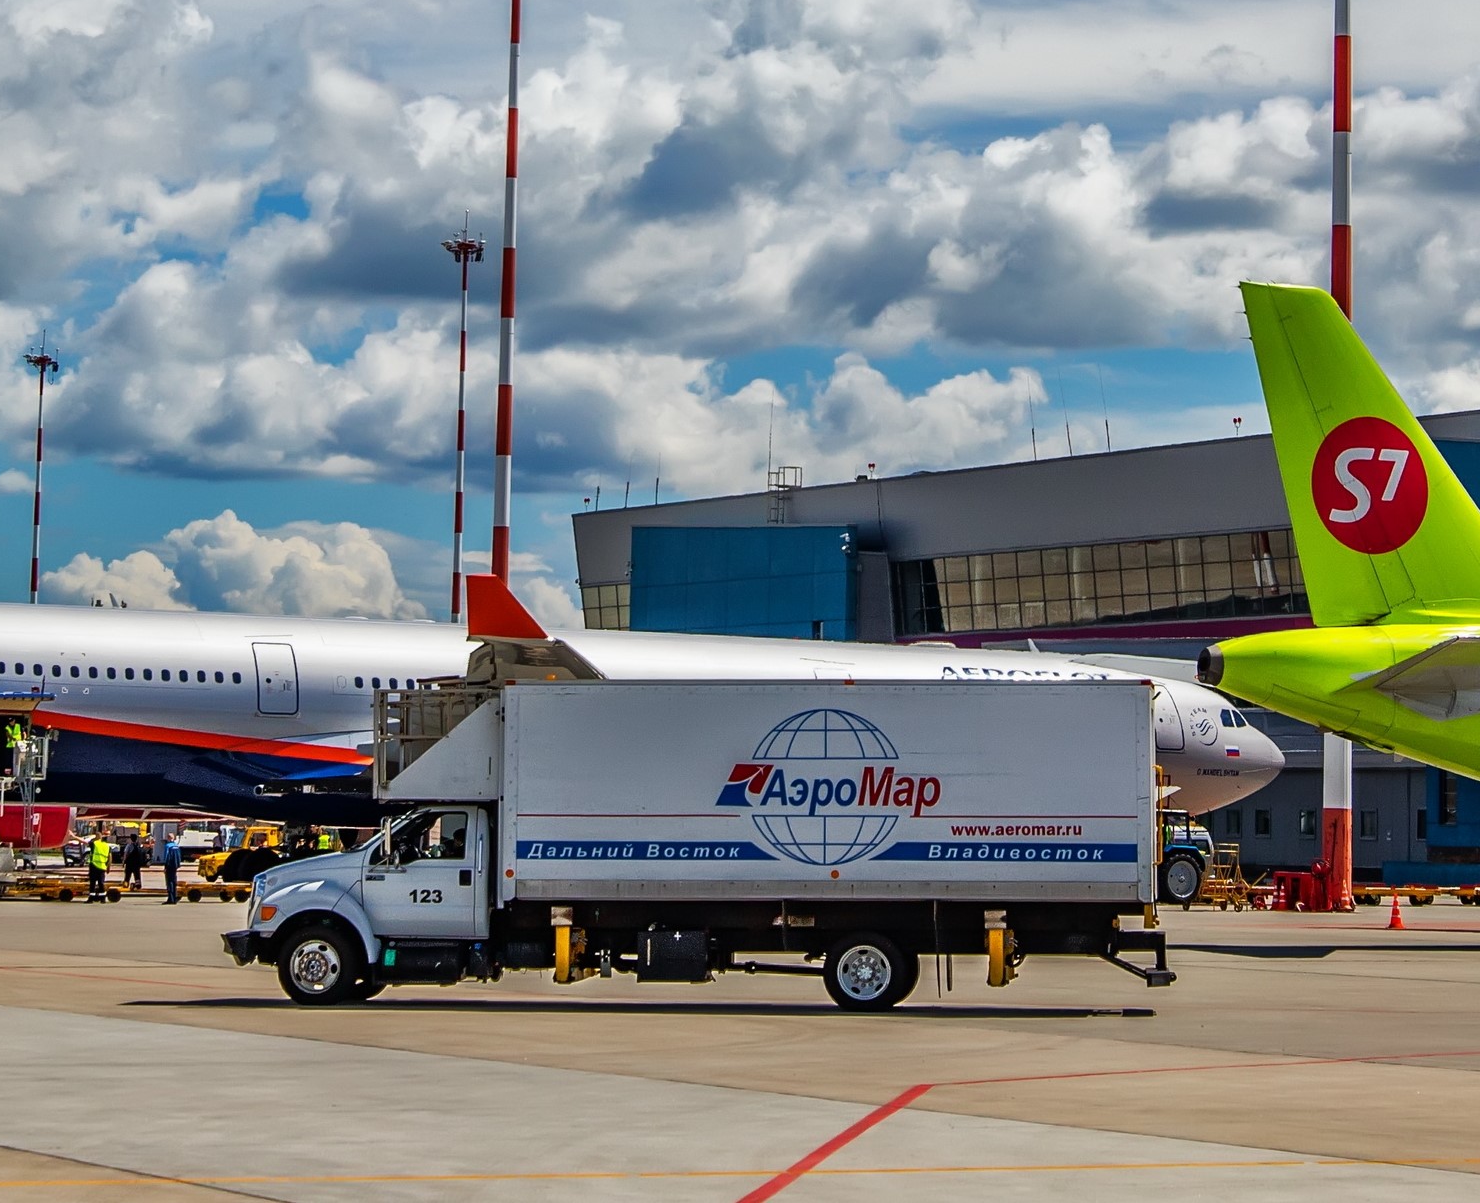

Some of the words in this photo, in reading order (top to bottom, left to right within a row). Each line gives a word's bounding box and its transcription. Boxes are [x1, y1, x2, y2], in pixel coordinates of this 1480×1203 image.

[1329, 447, 1409, 523] S7
[760, 766, 941, 817] АэроМар
[951, 825, 1082, 836] www.aeromar.ru
[527, 843, 635, 858] Дальний
[646, 844, 740, 858] Восток
[928, 845, 1104, 860] Владивосток
[409, 889, 443, 904] 123
